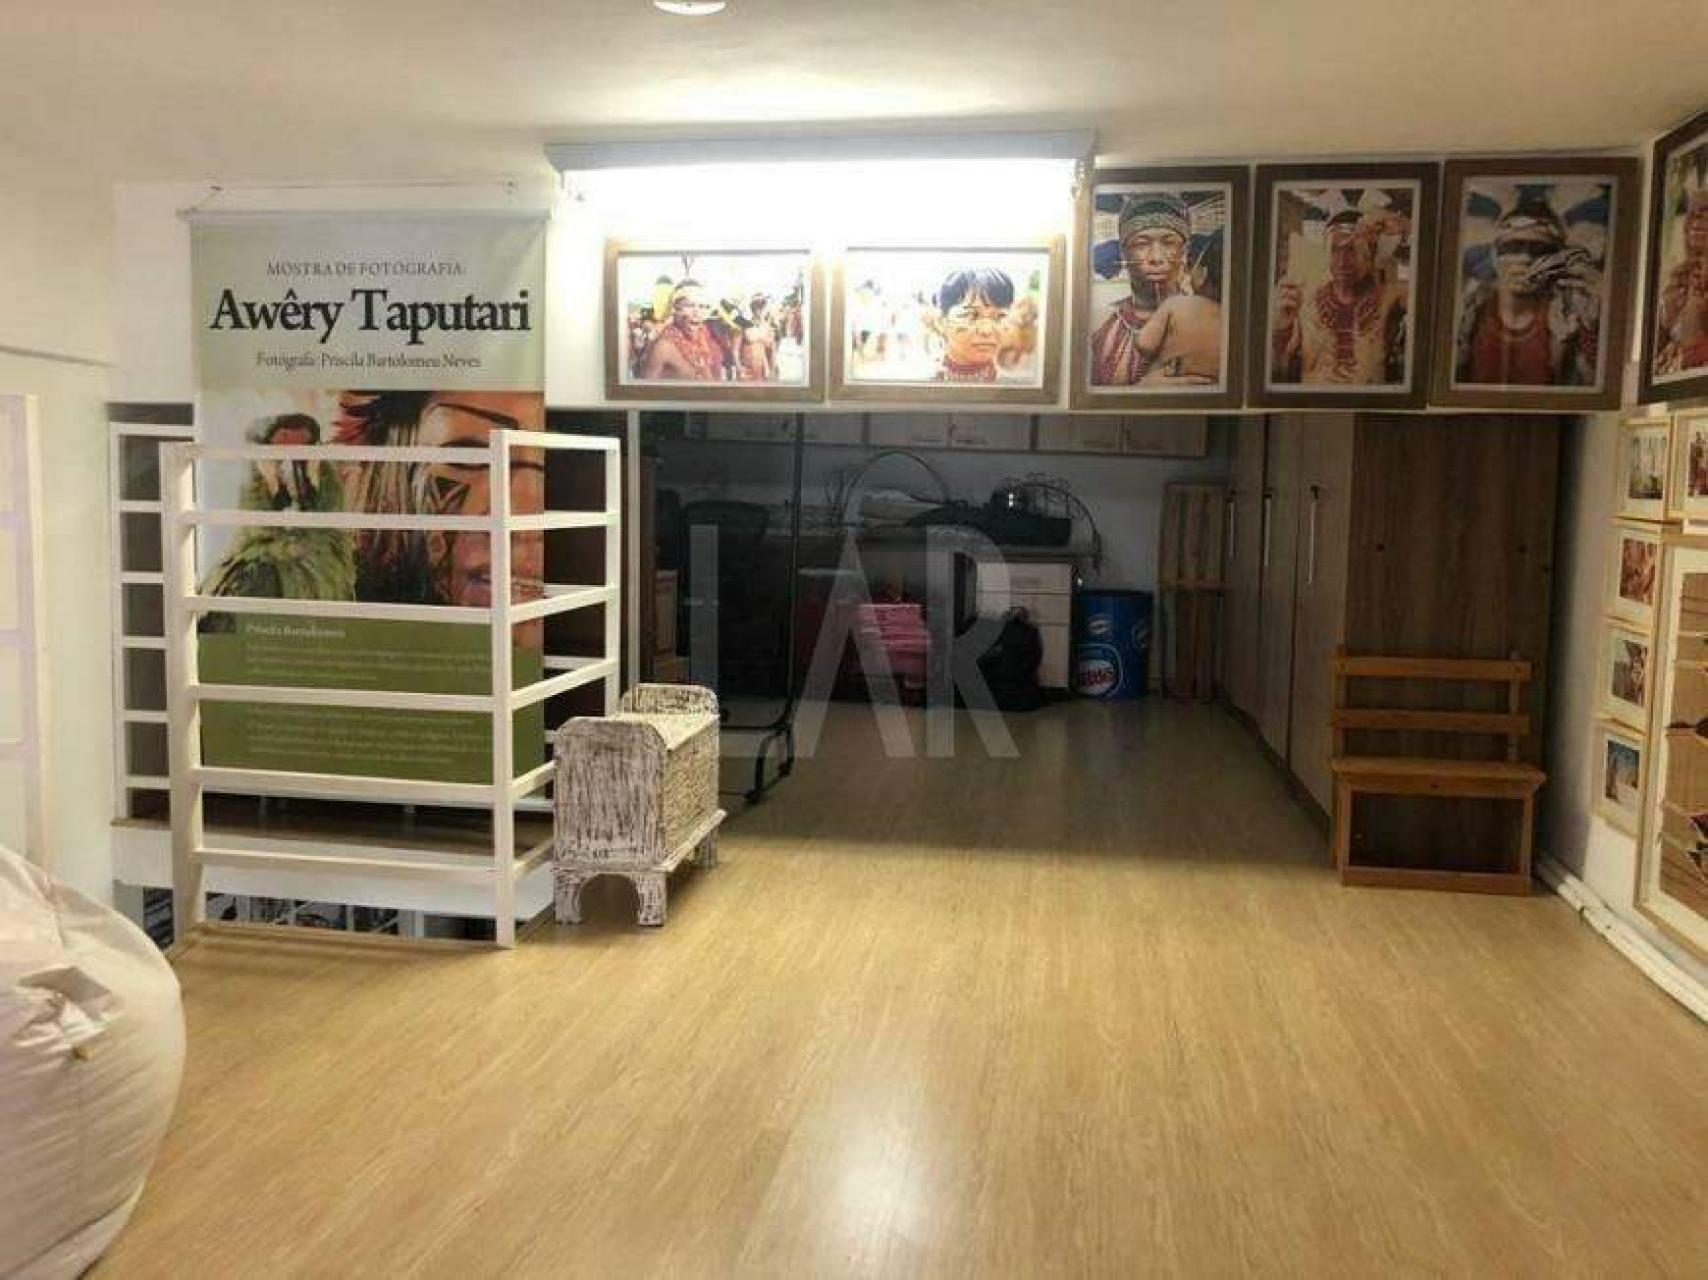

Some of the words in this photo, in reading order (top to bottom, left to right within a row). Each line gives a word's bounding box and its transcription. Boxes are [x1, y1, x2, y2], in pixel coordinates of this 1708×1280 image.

[267, 261, 332, 276] MOSTRA
[335, 261, 358, 276] DE
[209, 288, 344, 344] Awêry
[351, 289, 532, 346] Taputari
[321, 352, 364, 369] Priscila
[442, 352, 482, 368] Neves
